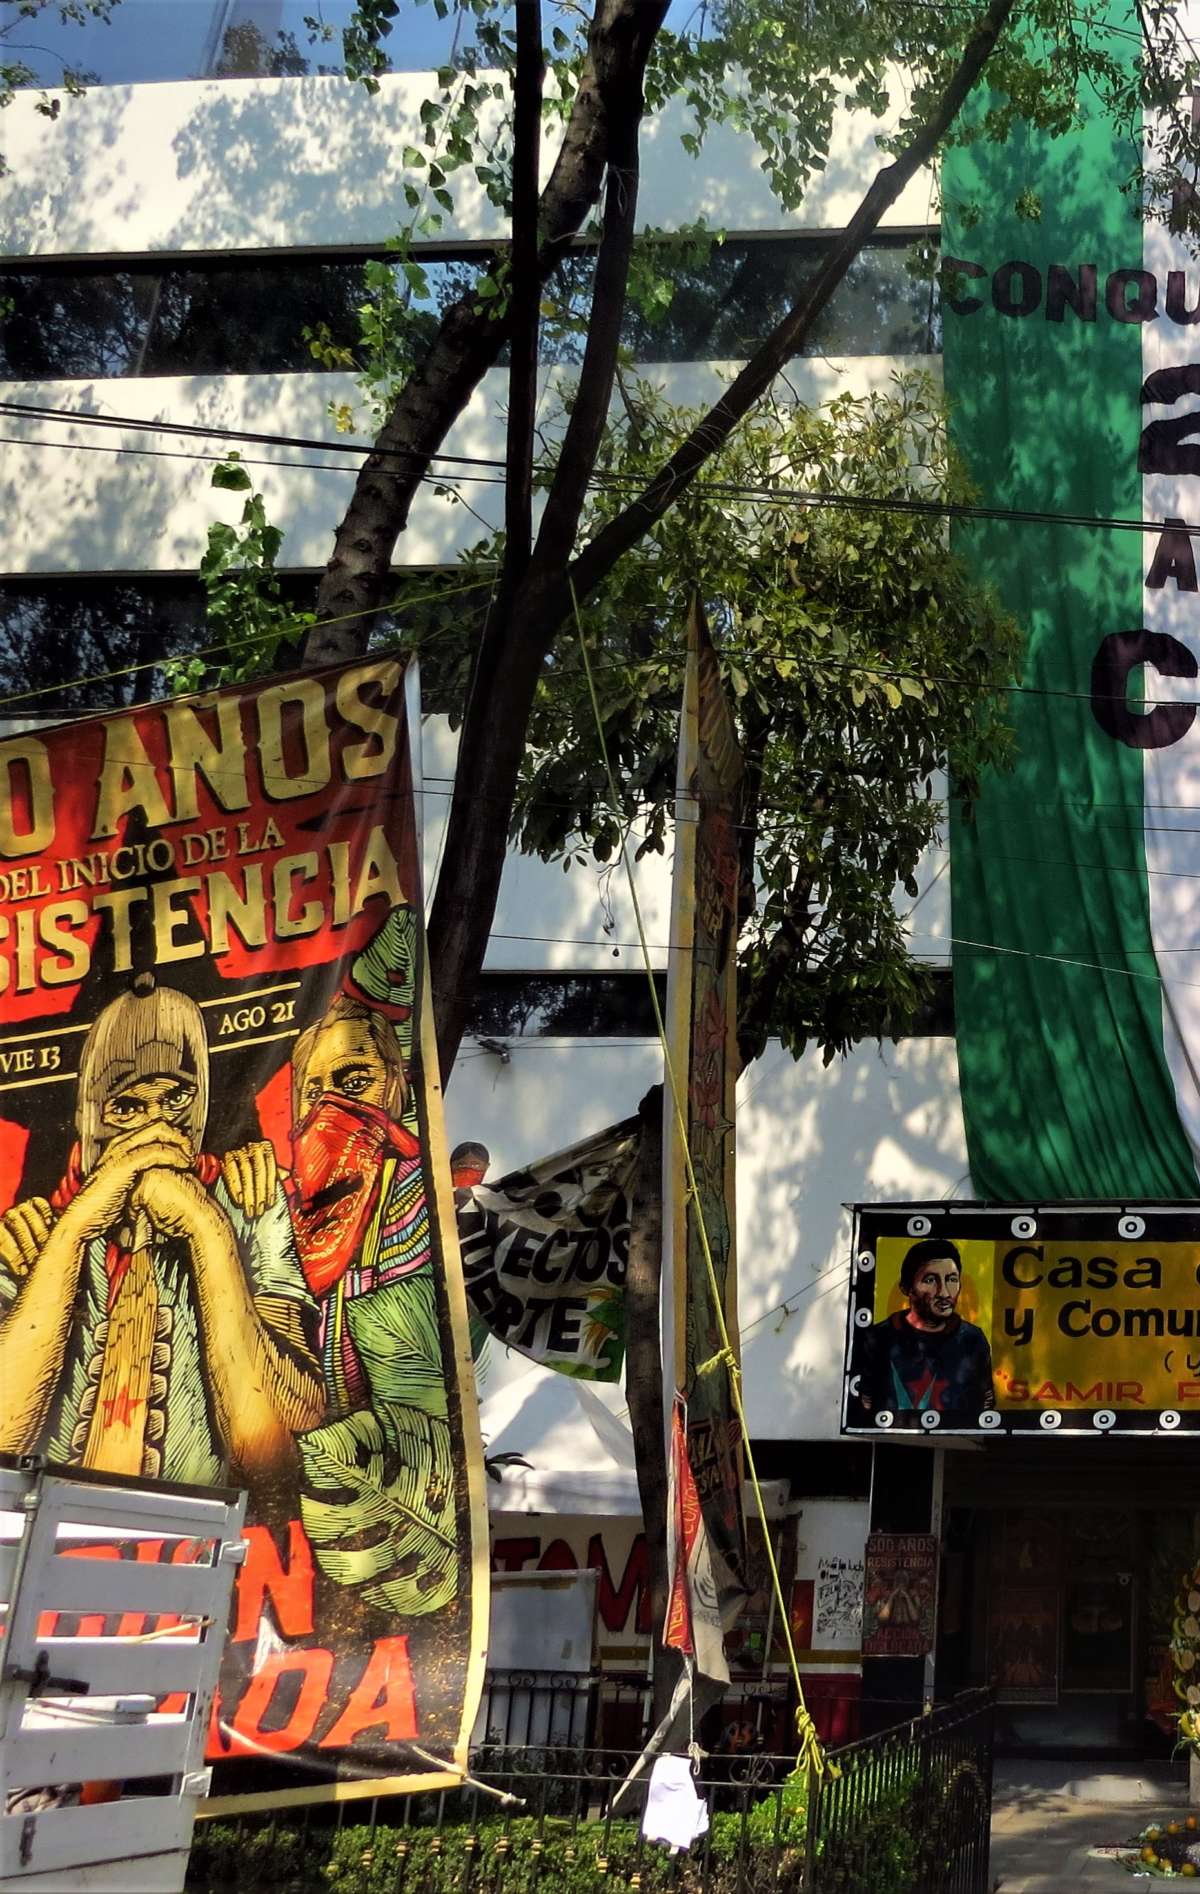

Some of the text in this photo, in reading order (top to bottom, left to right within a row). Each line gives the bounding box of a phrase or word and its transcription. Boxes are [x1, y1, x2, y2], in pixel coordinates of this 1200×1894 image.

[58, 838, 176, 893] INICIO
[183, 826, 230, 867] DE
[239, 817, 286, 854] LA
[0, 825, 408, 993] ISTENCIA
[40, 1046, 62, 1071] 13
[219, 1003, 267, 1036] AGO
[271, 1001, 296, 1025] 21
[1001, 1246, 1162, 1290] Casa
[1004, 1309, 1034, 1346] y
[867, 1556, 935, 1568] RESISTENCIA
[868, 1538, 894, 1552] 500
